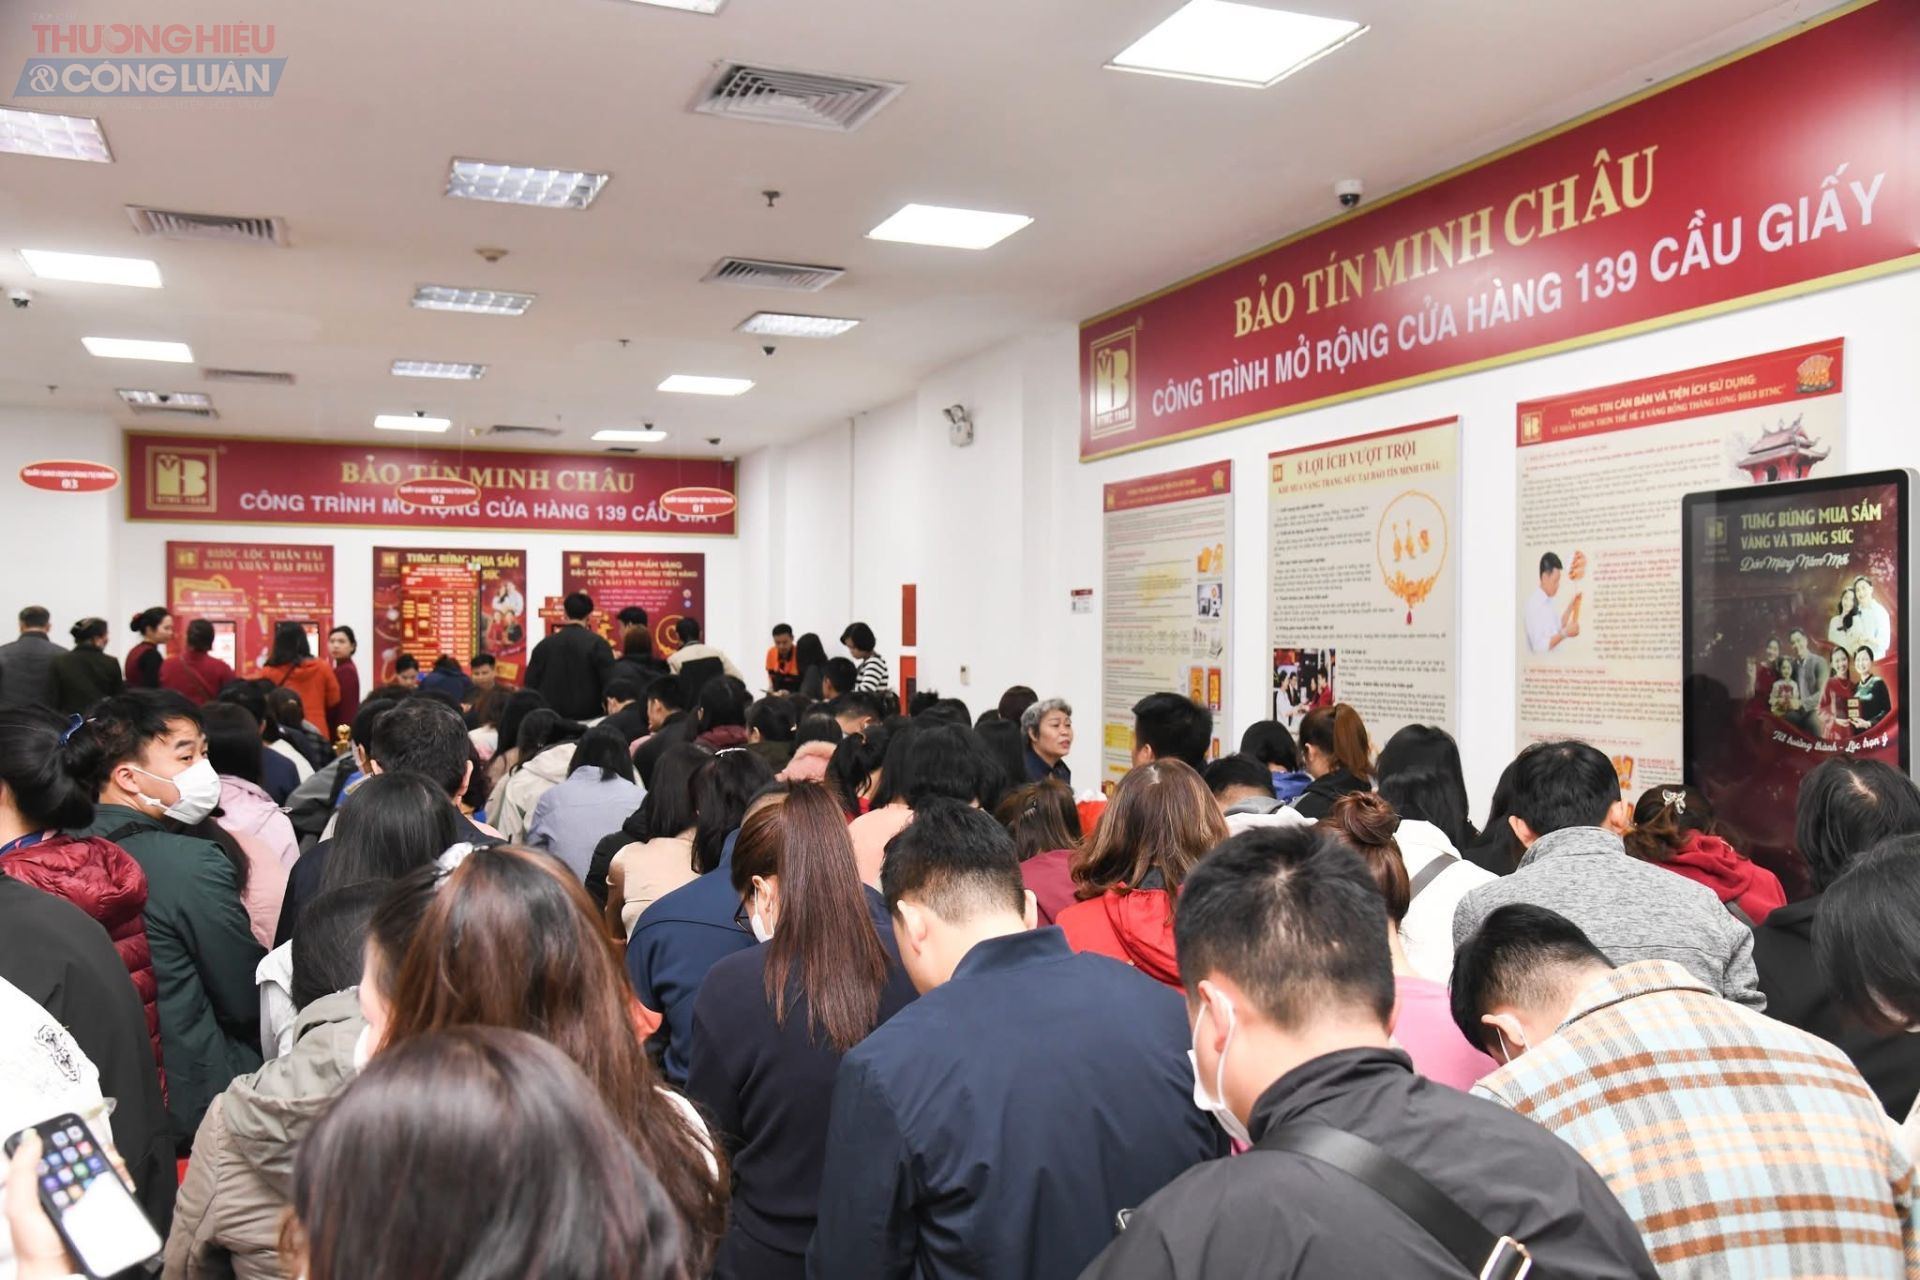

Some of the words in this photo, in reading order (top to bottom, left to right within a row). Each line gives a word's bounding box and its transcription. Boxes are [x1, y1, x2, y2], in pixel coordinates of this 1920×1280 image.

[1233, 274, 1295, 338] BẢO
[1302, 251, 1365, 314] TÍN
[1373, 206, 1494, 293] MINH
[1504, 144, 1659, 246] CHÂU
[1152, 378, 1203, 417] CÔNG
[1208, 359, 1268, 402] TRÌNH
[1275, 334, 1311, 384] MỞ
[1316, 323, 1389, 374] RỘNG
[1397, 295, 1457, 350] CỬA
[1467, 271, 1562, 332] HÀNG
[1575, 250, 1638, 302] 139
[1649, 209, 1742, 282] CẦU
[1757, 162, 1886, 253] GIẤY
[341, 454, 401, 485] BẢO
[468, 466, 549, 490] MINH
[556, 466, 635, 493] CHÂU
[1326, 452, 1347, 471] ÍCH
[239, 489, 305, 512] CÔNG
[310, 491, 376, 513] TRÌNH
[485, 495, 528, 517] CỬA
[533, 499, 590, 520] HÀNG
[596, 505, 627, 521] 139
[1818, 506, 1848, 524] MUA
[1851, 498, 1882, 522] SẮM
[1773, 531, 1788, 548] VÀ
[1790, 530, 1829, 547] TRANG
[1830, 526, 1854, 545] SỨC
